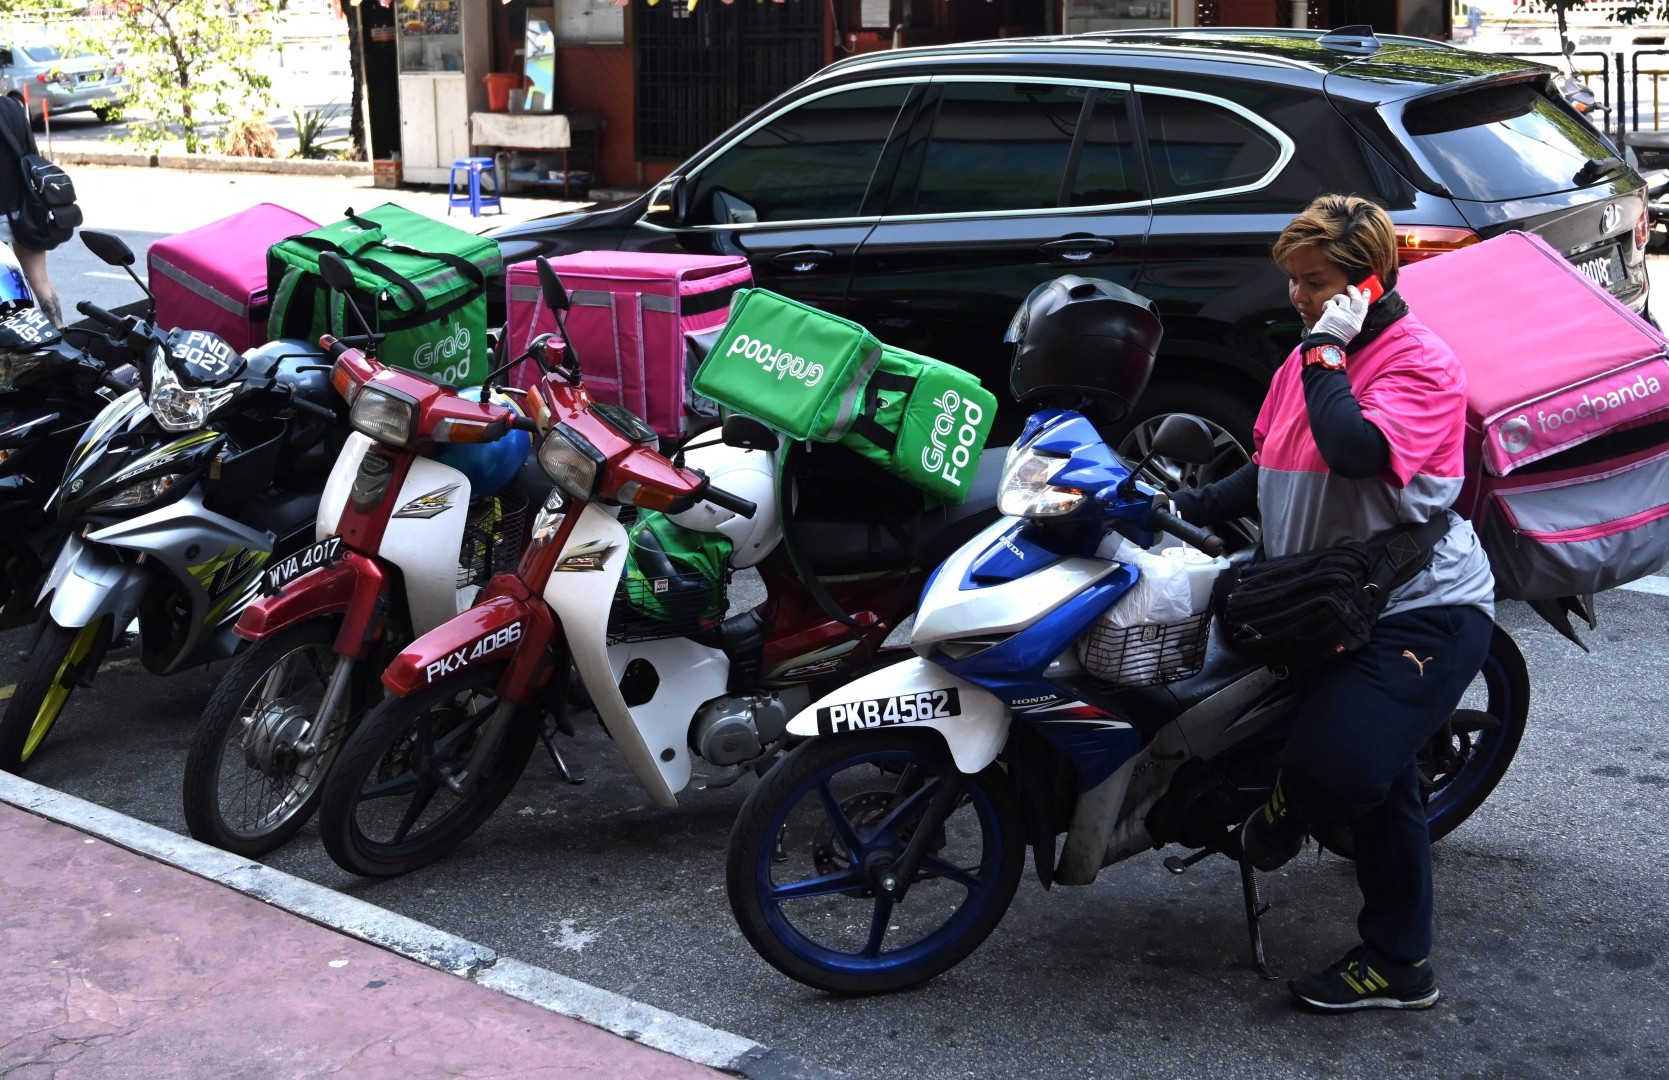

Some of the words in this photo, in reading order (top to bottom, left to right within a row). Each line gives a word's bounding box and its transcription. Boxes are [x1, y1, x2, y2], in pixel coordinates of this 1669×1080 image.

[0, 317, 39, 341] 7449
[13, 307, 50, 330] PNH
[172, 343, 230, 376] 3027
[413, 322, 471, 369] Grab
[430, 348, 471, 385] od
[725, 334, 824, 387] GrabFood
[1537, 375, 1662, 434] foodpanda
[922, 389, 961, 473] Grab
[269, 557, 299, 587] WVA
[302, 537, 341, 568] 4017
[426, 647, 468, 684] PKX
[470, 621, 521, 660] 4086
[1011, 693, 1058, 705] HONDA
